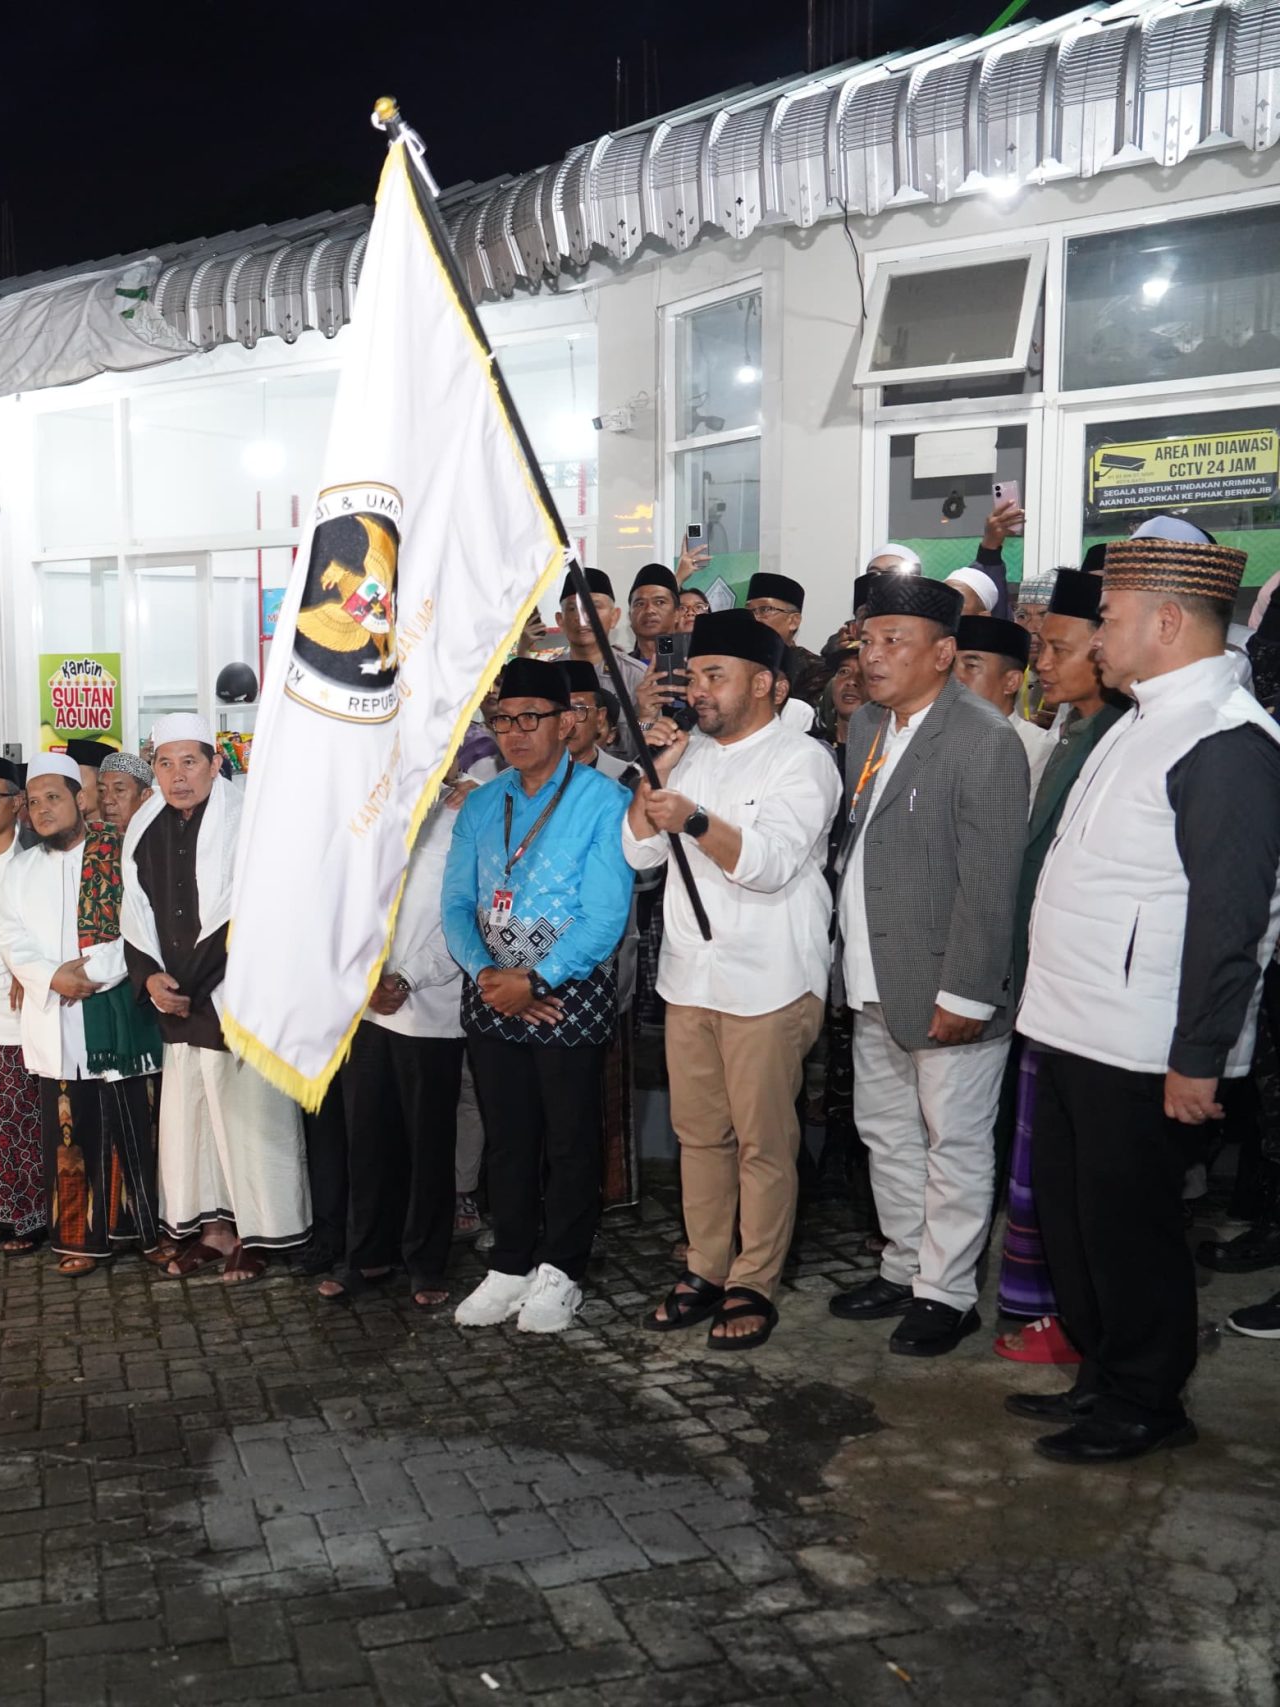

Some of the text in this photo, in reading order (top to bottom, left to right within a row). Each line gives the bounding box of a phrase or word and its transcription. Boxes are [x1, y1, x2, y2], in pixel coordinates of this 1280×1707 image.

[1155, 437, 1273, 461] AREA INI DIAWASI
[1169, 461, 1203, 478] CCTV
[1207, 459, 1225, 475] 24
[1228, 457, 1256, 473] JAM
[1099, 486, 1272, 507] AKAN DILAPORKAN KE PIHAK BERWAJIB
[1103, 476, 1267, 498] SEGALA BENTUK TINDAKAN KRIMINAL
[341, 496, 354, 511] &
[62, 659, 102, 679] Kantin
[52, 687, 113, 708] SULTAN
[55, 707, 111, 729] AGUNG
